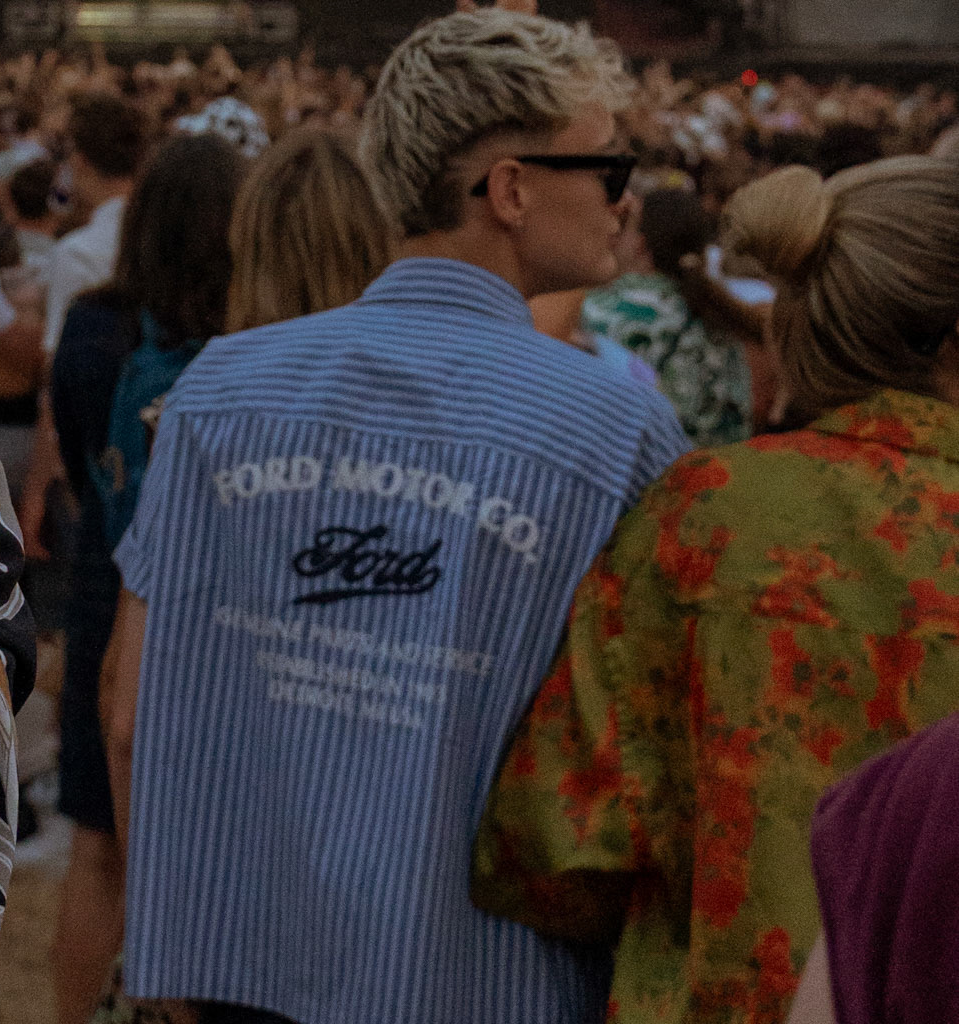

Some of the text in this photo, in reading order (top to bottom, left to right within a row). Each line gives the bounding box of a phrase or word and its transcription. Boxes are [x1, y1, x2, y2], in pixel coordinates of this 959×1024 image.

[214, 456, 320, 505] FORD
[332, 458, 474, 514] MOTOR
[292, 525, 442, 588] Ford
